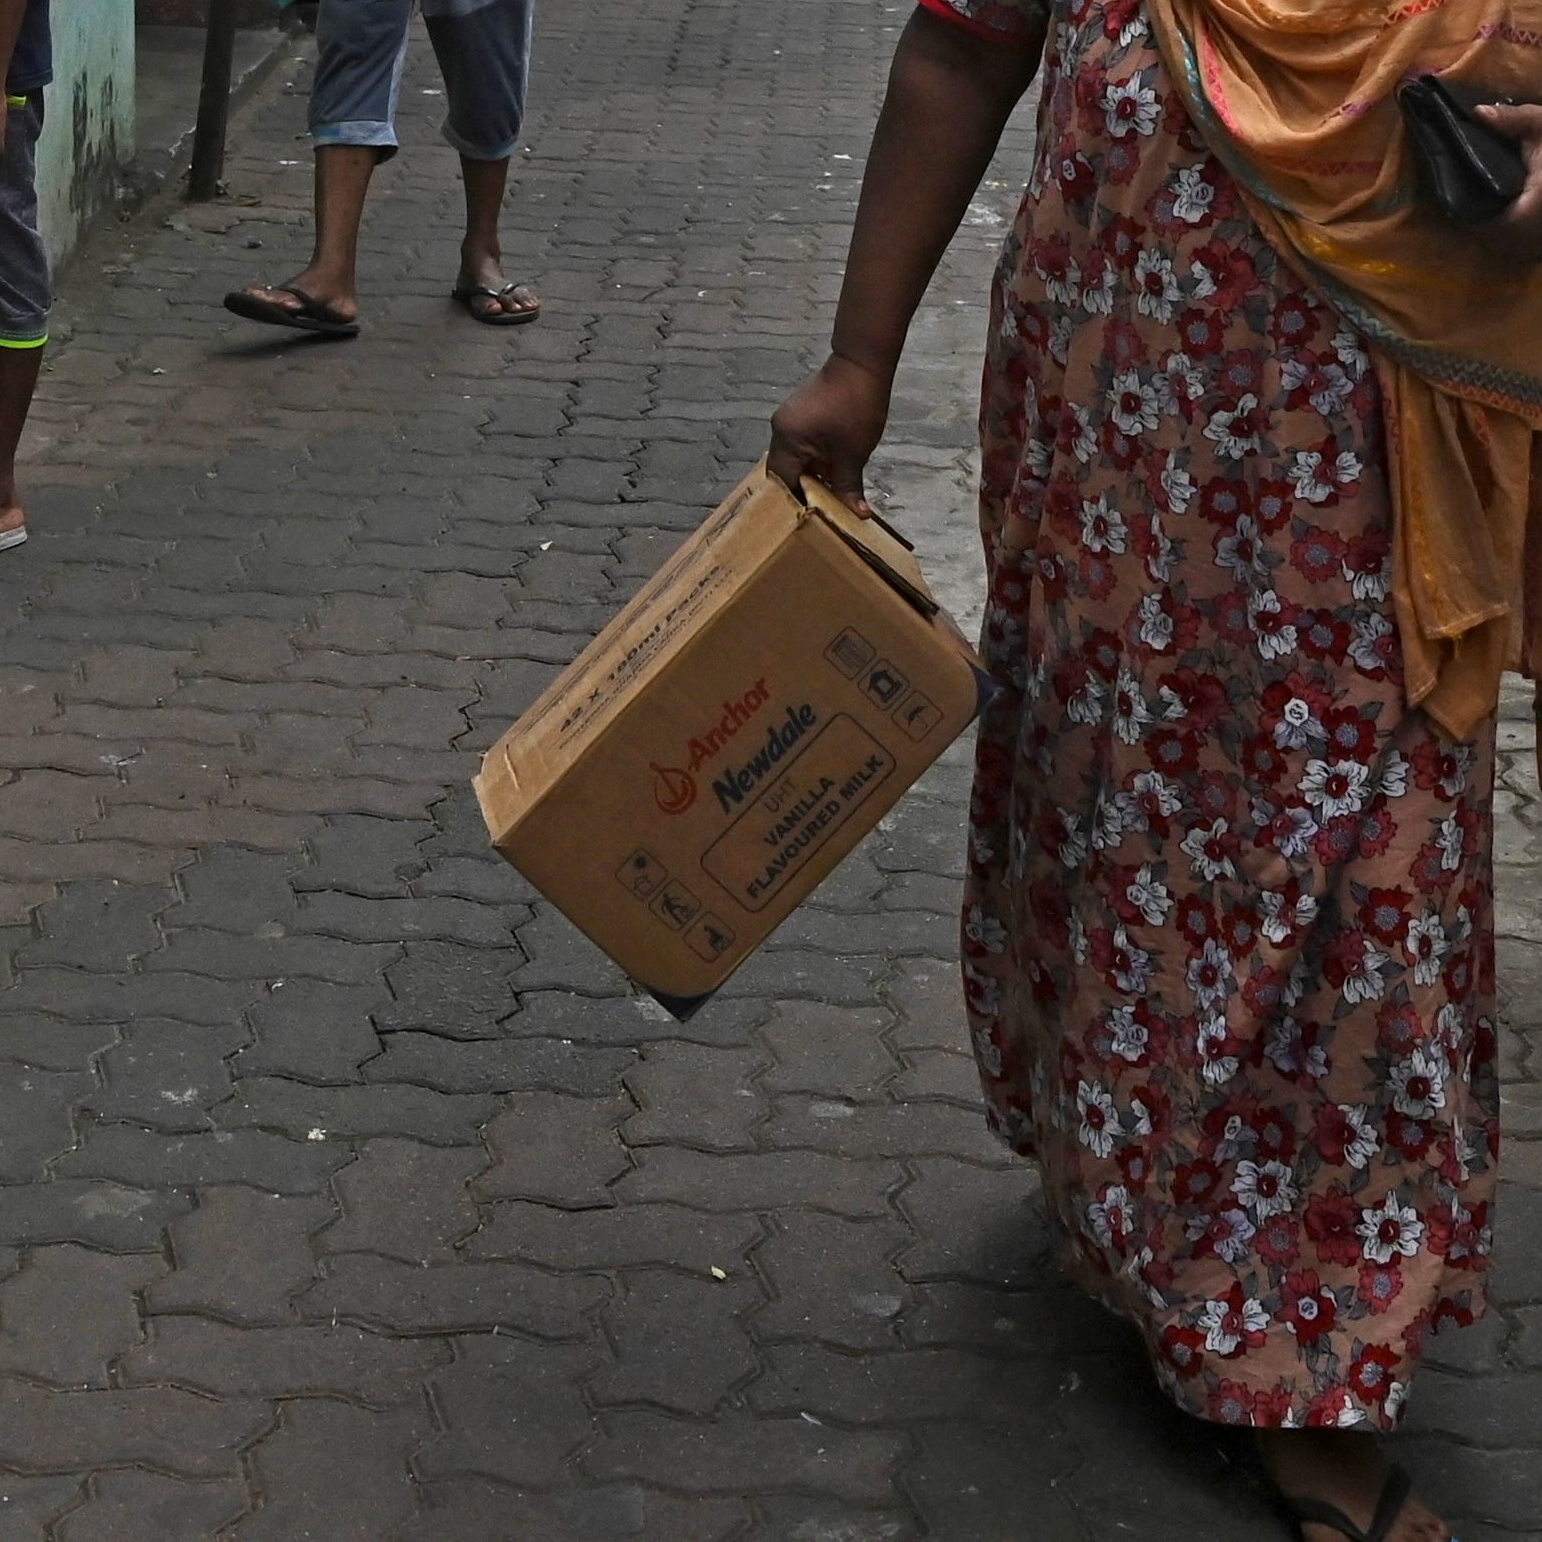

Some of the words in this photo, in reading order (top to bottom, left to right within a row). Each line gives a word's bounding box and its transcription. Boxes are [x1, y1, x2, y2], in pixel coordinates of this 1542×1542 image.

[560, 706, 582, 732] 42
[666, 566, 720, 623] Packs
[687, 677, 770, 773] Anchor
[712, 703, 818, 816] Newdale
[746, 800, 841, 899] FLAVOURED
[839, 754, 885, 800] MILK
[763, 777, 835, 847] VANILLA
[764, 777, 797, 813] UHT
